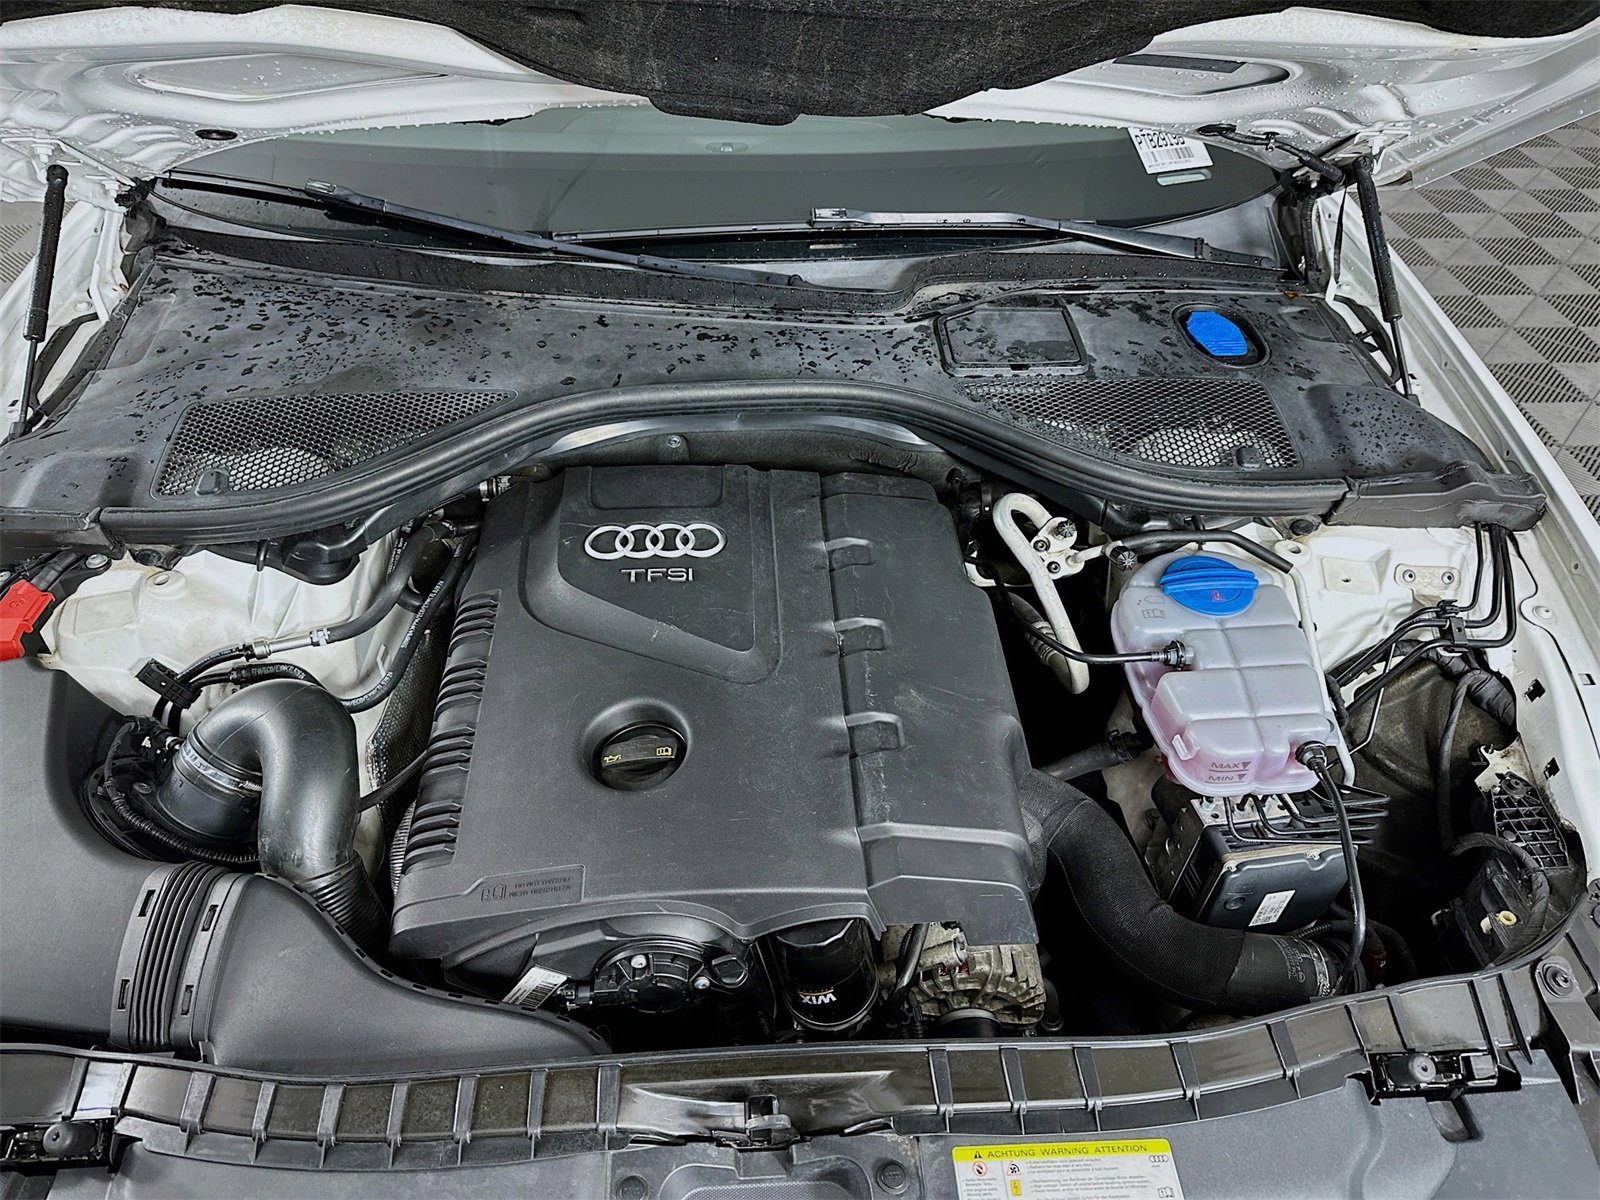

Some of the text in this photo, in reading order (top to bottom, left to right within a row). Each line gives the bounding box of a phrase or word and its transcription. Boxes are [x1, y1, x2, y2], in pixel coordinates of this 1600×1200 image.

[620, 568, 694, 583] TFSI
[800, 993, 837, 1004] WIX
[987, 1145, 1147, 1158] ACHTUNG WARNING ATTENTION
